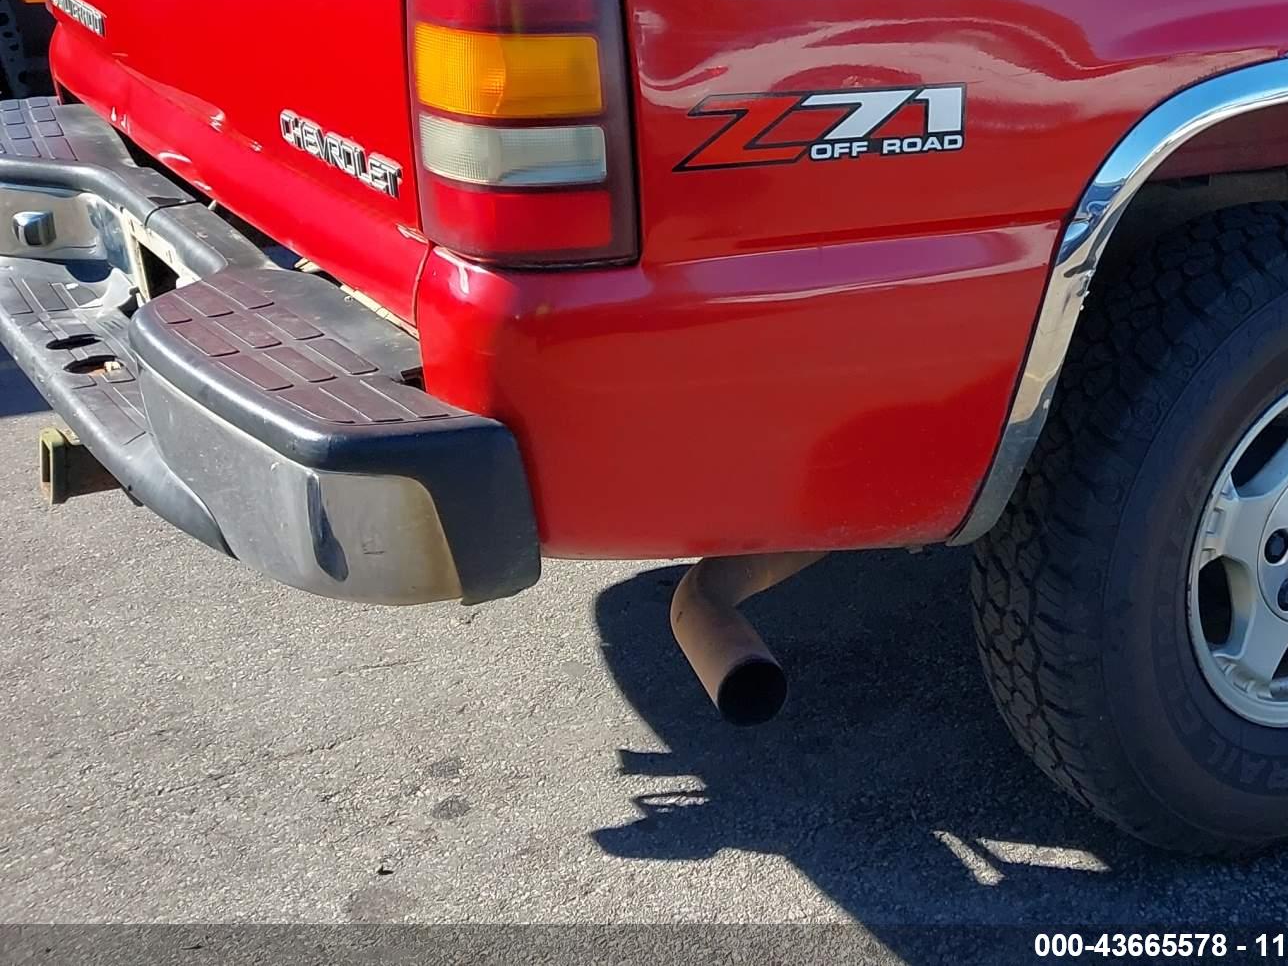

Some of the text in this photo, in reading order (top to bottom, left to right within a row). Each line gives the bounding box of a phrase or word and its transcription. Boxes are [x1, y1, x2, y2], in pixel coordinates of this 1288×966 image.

[280, 109, 403, 200] CHEVROLET
[672, 82, 967, 173] Z71
[810, 135, 963, 160] OFF ROAD
